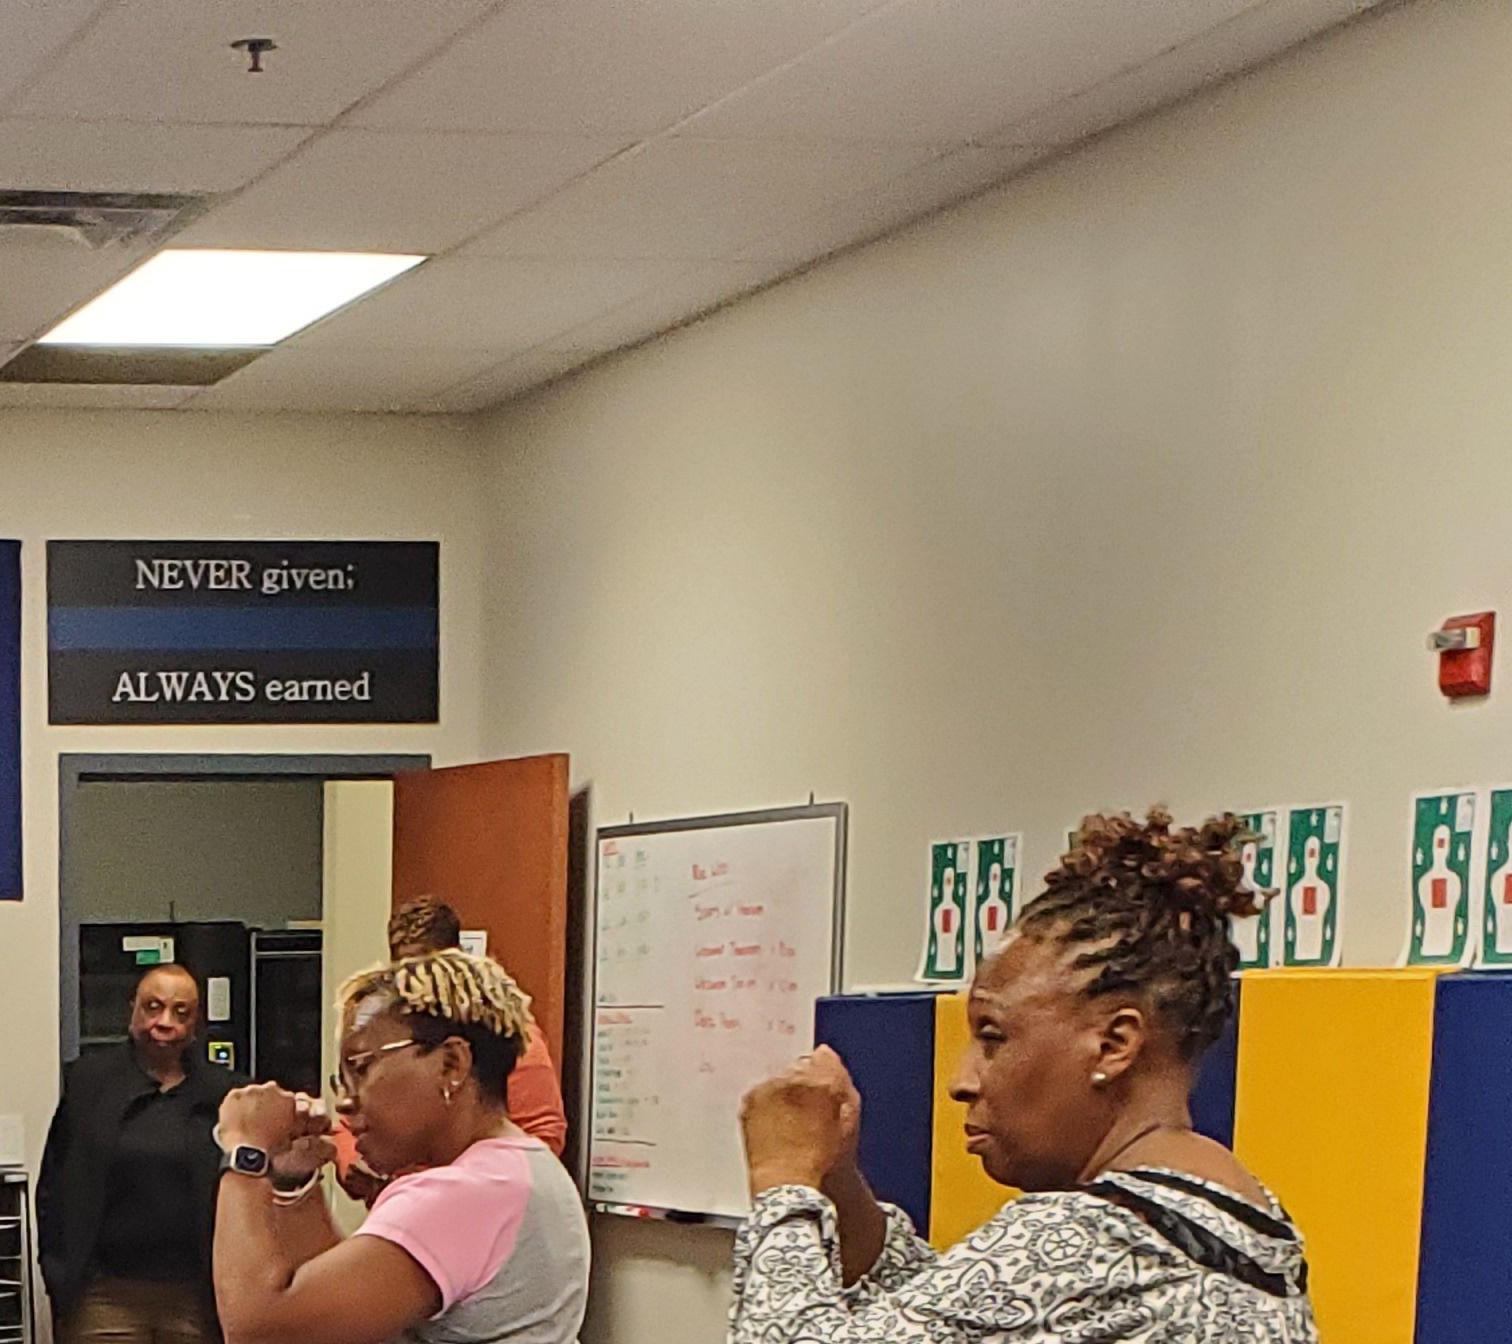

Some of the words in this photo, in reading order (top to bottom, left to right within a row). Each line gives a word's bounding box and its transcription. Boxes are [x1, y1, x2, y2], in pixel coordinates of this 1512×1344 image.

[135, 559, 253, 590] NEVER
[111, 671, 256, 702] ALWAYS
[264, 671, 371, 701] earned
